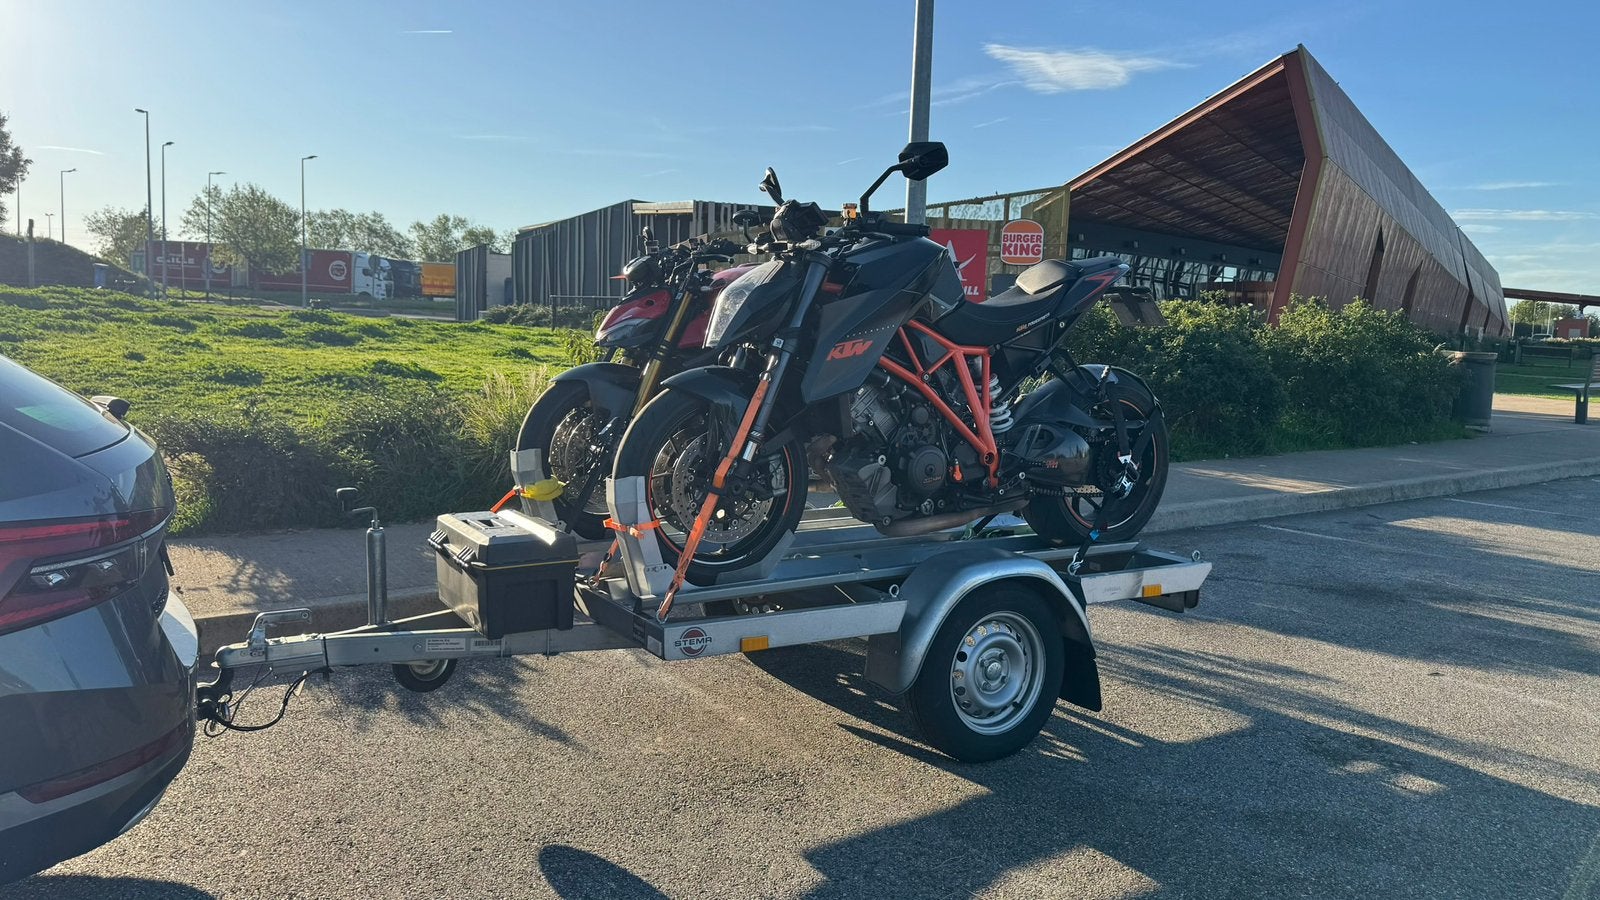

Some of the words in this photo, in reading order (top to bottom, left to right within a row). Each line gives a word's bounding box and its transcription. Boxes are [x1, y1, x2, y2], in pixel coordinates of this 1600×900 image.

[1002, 234, 1042, 243] BURGER
[1002, 243, 1042, 256] KING
[963, 285, 979, 295] ILL
[826, 339, 873, 361] KTM
[674, 636, 713, 647] STEMA
